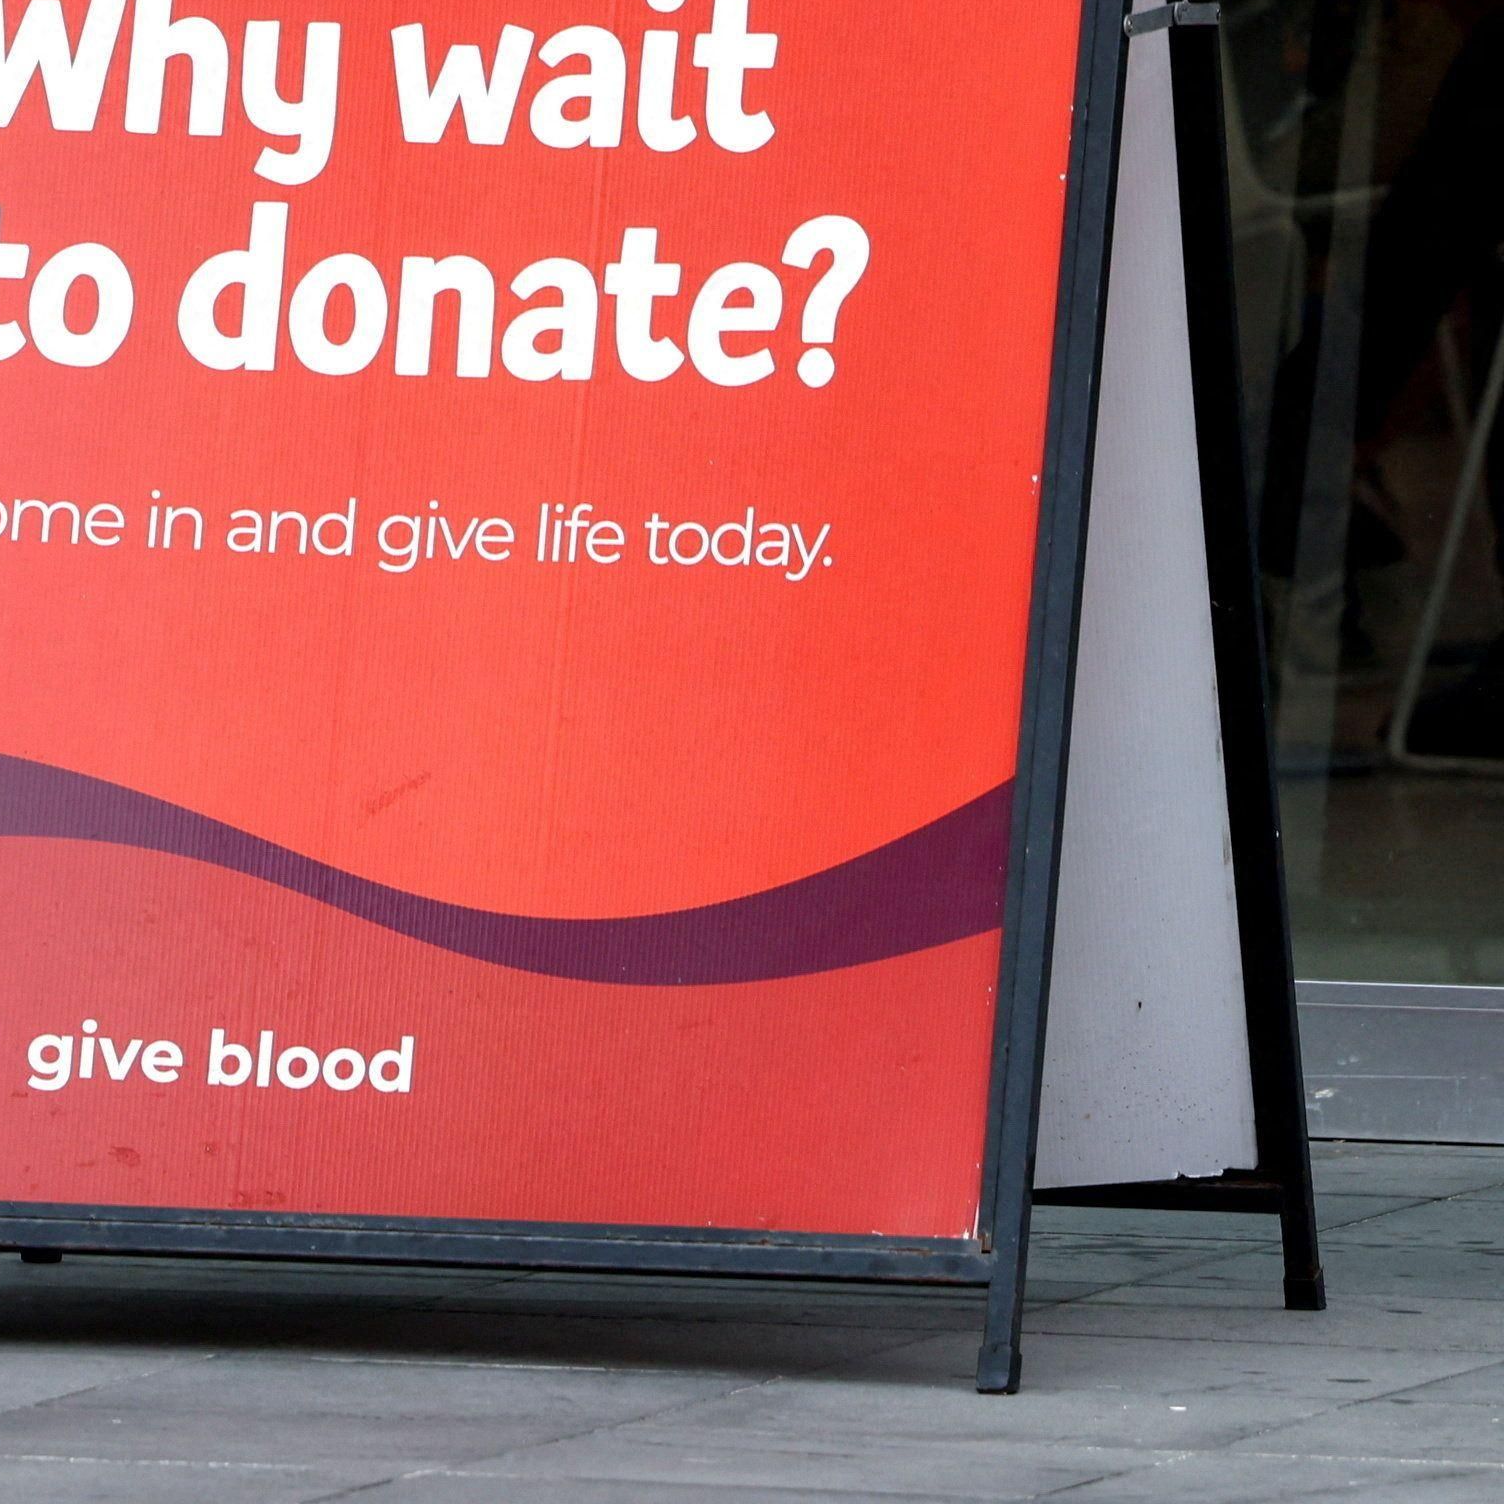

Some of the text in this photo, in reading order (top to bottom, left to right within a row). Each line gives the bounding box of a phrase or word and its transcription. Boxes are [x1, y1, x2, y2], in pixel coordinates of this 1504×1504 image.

[177, 201, 870, 389] donate?
[147, 489, 203, 551] in
[226, 497, 357, 557] and
[377, 499, 515, 573] give
[537, 502, 625, 564] life
[644, 506, 833, 582] today.
[27, 1018, 415, 1093] give blood
